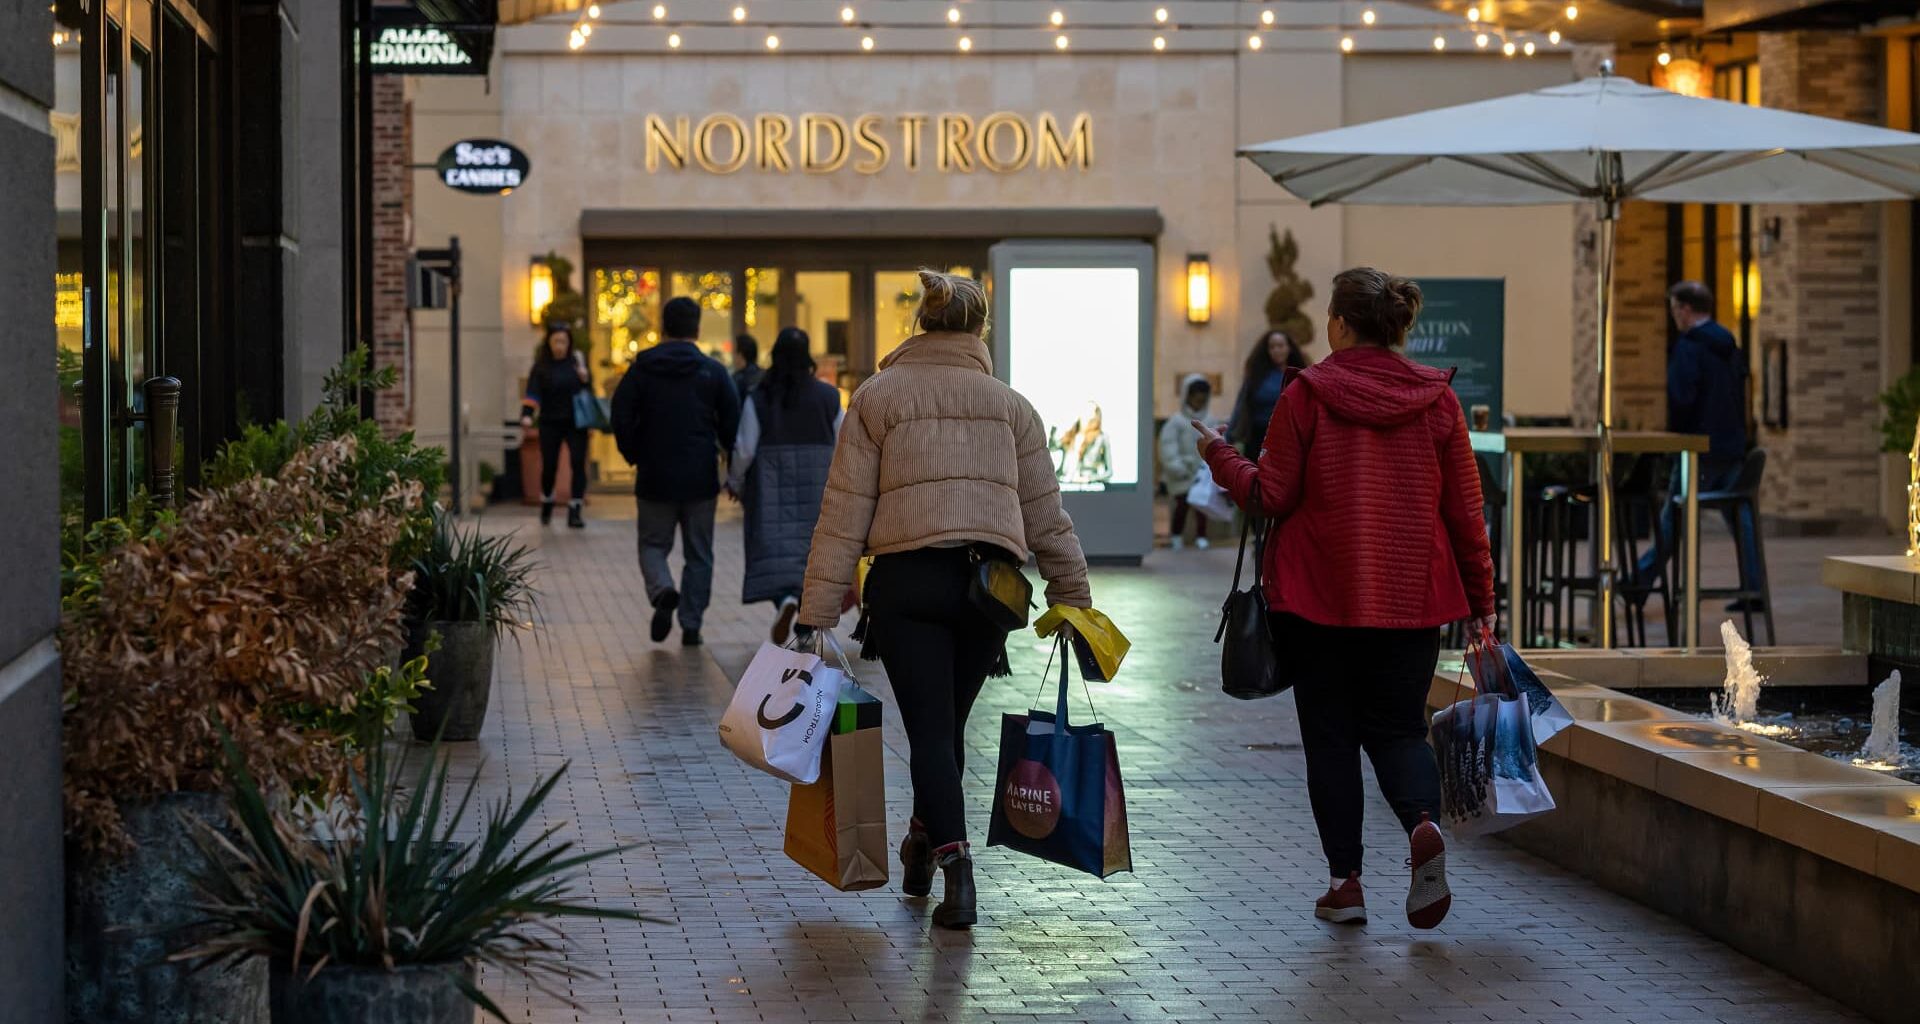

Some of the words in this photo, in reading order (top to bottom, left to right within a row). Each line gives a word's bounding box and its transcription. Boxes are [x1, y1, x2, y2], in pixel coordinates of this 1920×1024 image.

[380, 28, 450, 43] ALLE
[645, 111, 1095, 174] NORDSTROM
[456, 142, 511, 165] See's
[446, 168, 521, 187] CANDIES
[803, 688, 823, 745] NORDSTROM
[1011, 797, 1042, 814] LAYER
